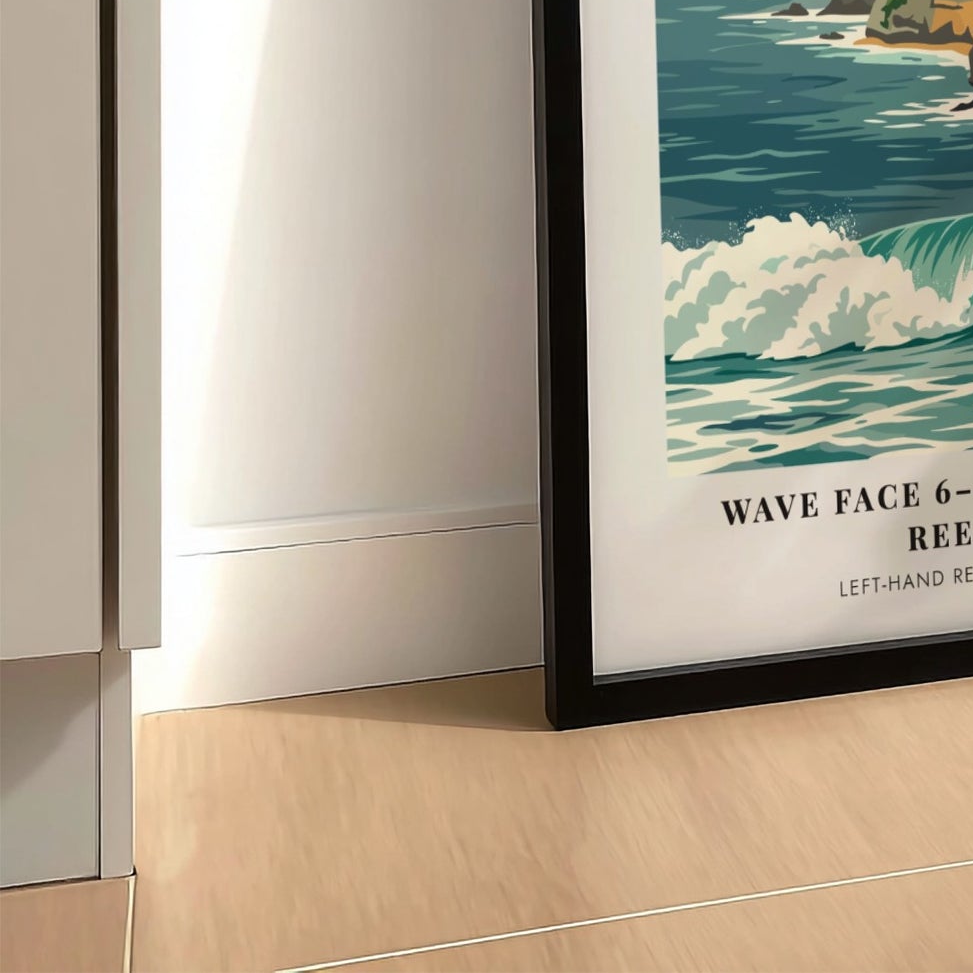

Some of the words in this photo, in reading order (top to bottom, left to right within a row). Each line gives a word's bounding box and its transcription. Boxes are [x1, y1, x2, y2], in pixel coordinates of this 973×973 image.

[720, 491, 819, 527] WAVE
[833, 481, 920, 516] FACE
[839, 569, 945, 598] LEFT-HAND
